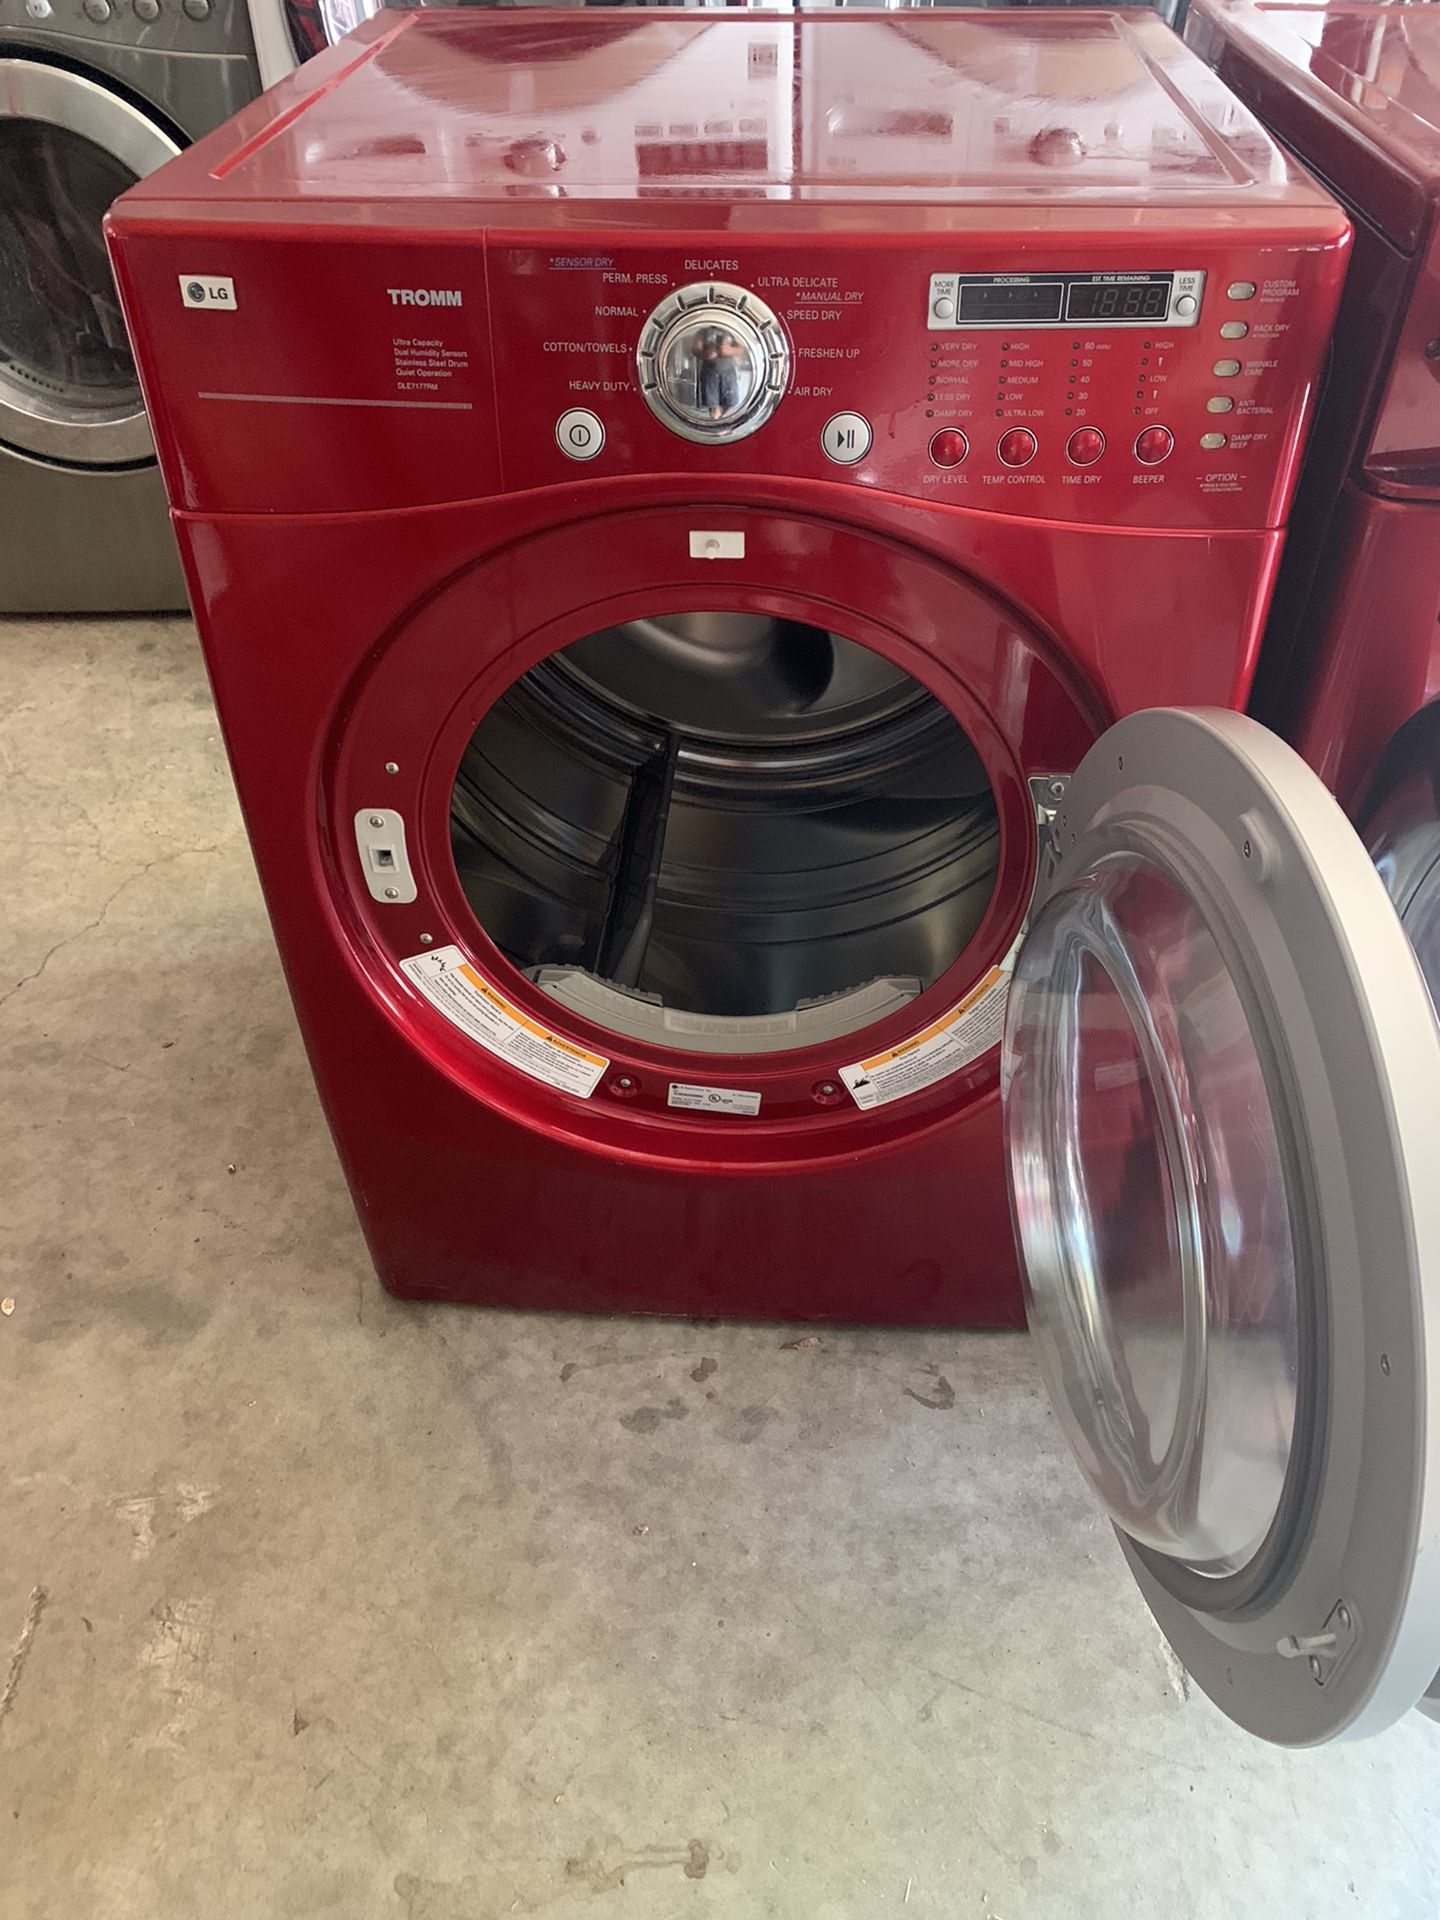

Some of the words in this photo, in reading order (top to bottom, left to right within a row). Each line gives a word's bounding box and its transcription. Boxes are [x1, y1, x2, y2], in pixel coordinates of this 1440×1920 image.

[554, 258, 592, 267] SENSOR
[595, 258, 614, 267] DRY
[684, 260, 739, 270] DELICATES
[602, 272, 634, 284] PERM.
[636, 273, 668, 284] PRESS
[758, 277, 789, 287] ULTRA
[792, 277, 838, 288] DELICATE
[1116, 274, 1151, 282] REMAINING
[934, 280, 954, 288] MORE
[1179, 284, 1194, 292] TIME
[1264, 280, 1296, 288] CUSTOM
[209, 287, 229, 300] LG
[800, 292, 844, 301] MANUAL
[844, 292, 864, 301] DRY
[937, 288, 952, 296] TIME
[1261, 288, 1300, 297] PROGRAM
[387, 289, 462, 306] TROMM
[595, 306, 638, 317] NORMAL
[786, 310, 818, 320] SPEED
[822, 310, 842, 321] DRY
[1253, 324, 1274, 332] RACK
[1274, 324, 1291, 332] DRY
[392, 338, 411, 346] Ultra
[412, 338, 443, 348] Capacity
[543, 342, 628, 353] COTTON/TOWELS
[940, 342, 960, 350] VERY
[960, 342, 978, 350] DRY
[1084, 342, 1095, 350] 60
[394, 348, 409, 356] Dual
[410, 349, 440, 358] Humidity
[441, 350, 468, 358] Sensors
[798, 348, 843, 358] FRESHEN
[846, 348, 860, 358] UP
[395, 358, 427, 366] Stainless
[428, 359, 447, 367] Steel
[448, 360, 469, 368] Drum
[938, 360, 960, 368] MORE
[962, 360, 978, 368] DRY
[1008, 360, 1024, 368] MID
[1082, 359, 1092, 367] 50
[1246, 360, 1278, 368] WRINKLE
[396, 368, 416, 376] Quiet
[416, 368, 452, 377] Operation
[1244, 368, 1264, 376] CARE
[936, 376, 970, 384] NORMAL
[1007, 376, 1039, 384] MEDIUM
[1080, 376, 1090, 384] 40
[1150, 375, 1168, 383] LOW
[569, 380, 600, 390] HEAVY
[603, 381, 630, 392] DUTY
[794, 386, 811, 396] AIR
[813, 386, 833, 397] DRY
[1078, 392, 1088, 400] 30
[1076, 408, 1086, 416] 20
[1236, 406, 1274, 415] BACTERIAL
[1253, 433, 1269, 441] DRY
[923, 474, 940, 484] DRY
[942, 474, 968, 484] LEVEL
[1007, 475, 1046, 484] CONTROL
[1062, 475, 1082, 484] TIME
[1084, 475, 1102, 484] DRY
[1132, 474, 1165, 484] BEEPER
[1205, 473, 1238, 482] OPTION
